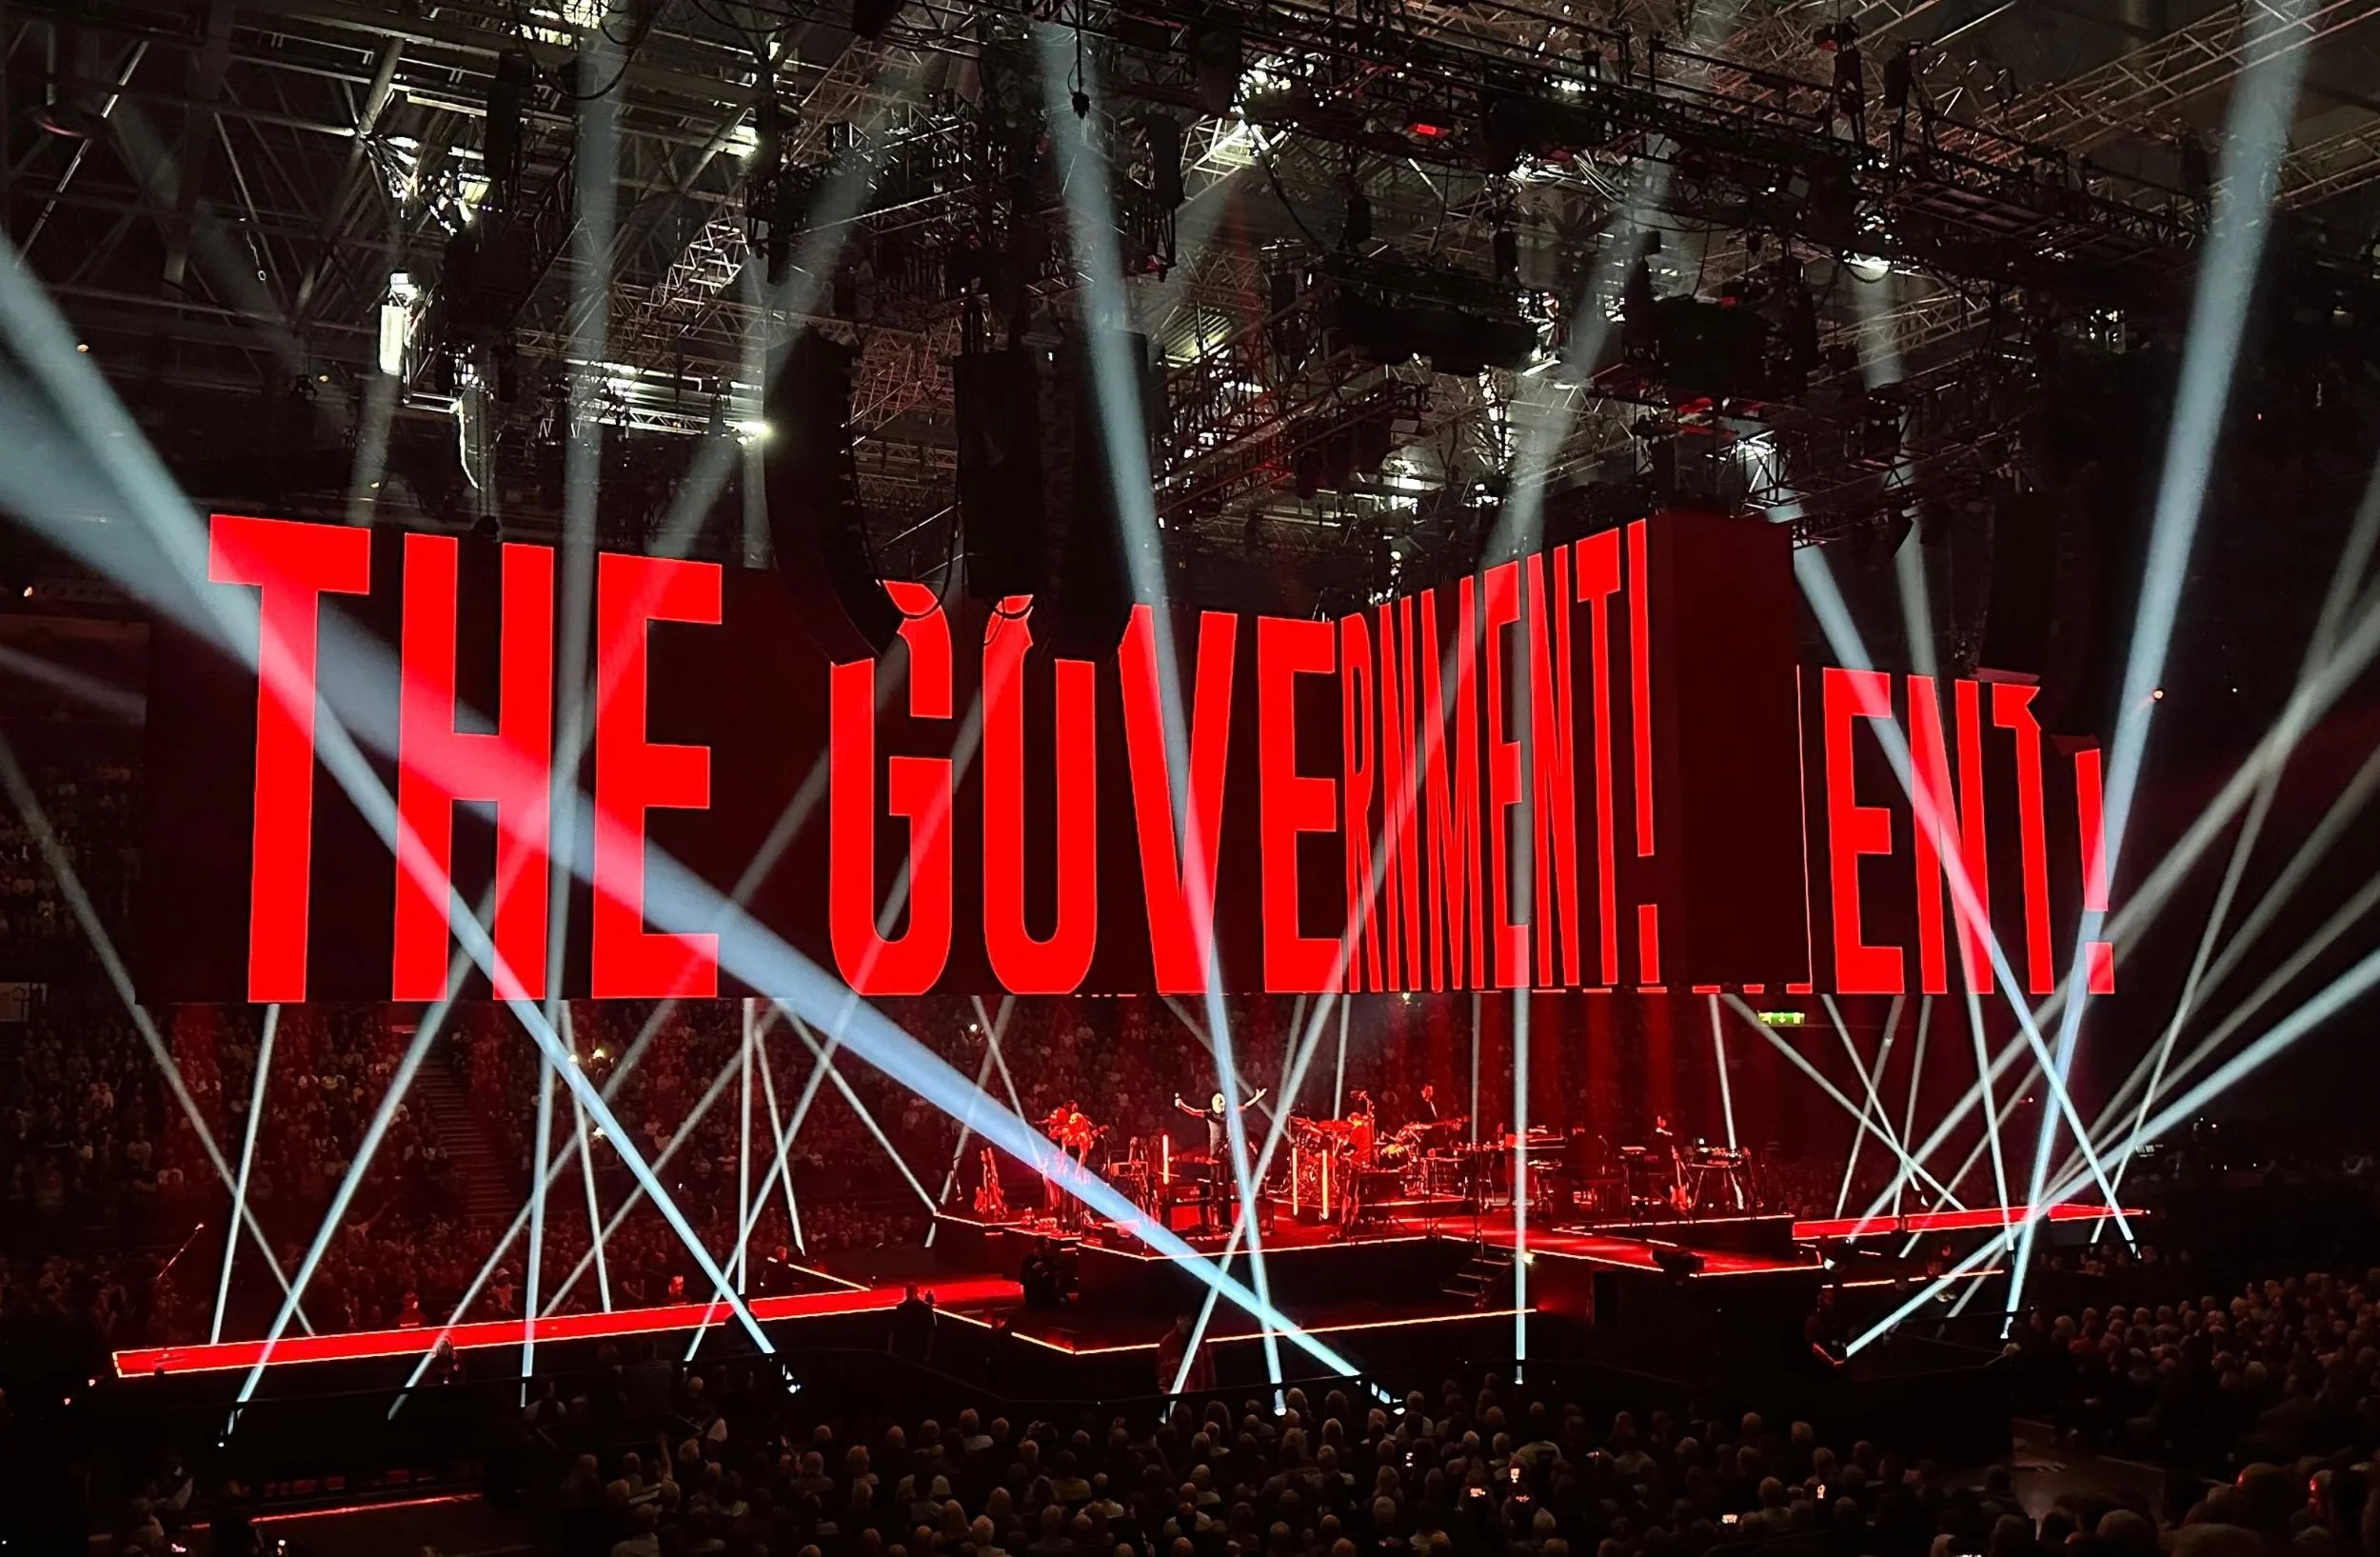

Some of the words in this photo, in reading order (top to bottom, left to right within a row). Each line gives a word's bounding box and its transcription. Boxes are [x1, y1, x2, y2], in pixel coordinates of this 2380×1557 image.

[208, 513, 724, 1003] THE
[829, 517, 1660, 996] GOVERNMENT!
[1796, 664, 2115, 996] ENT!
